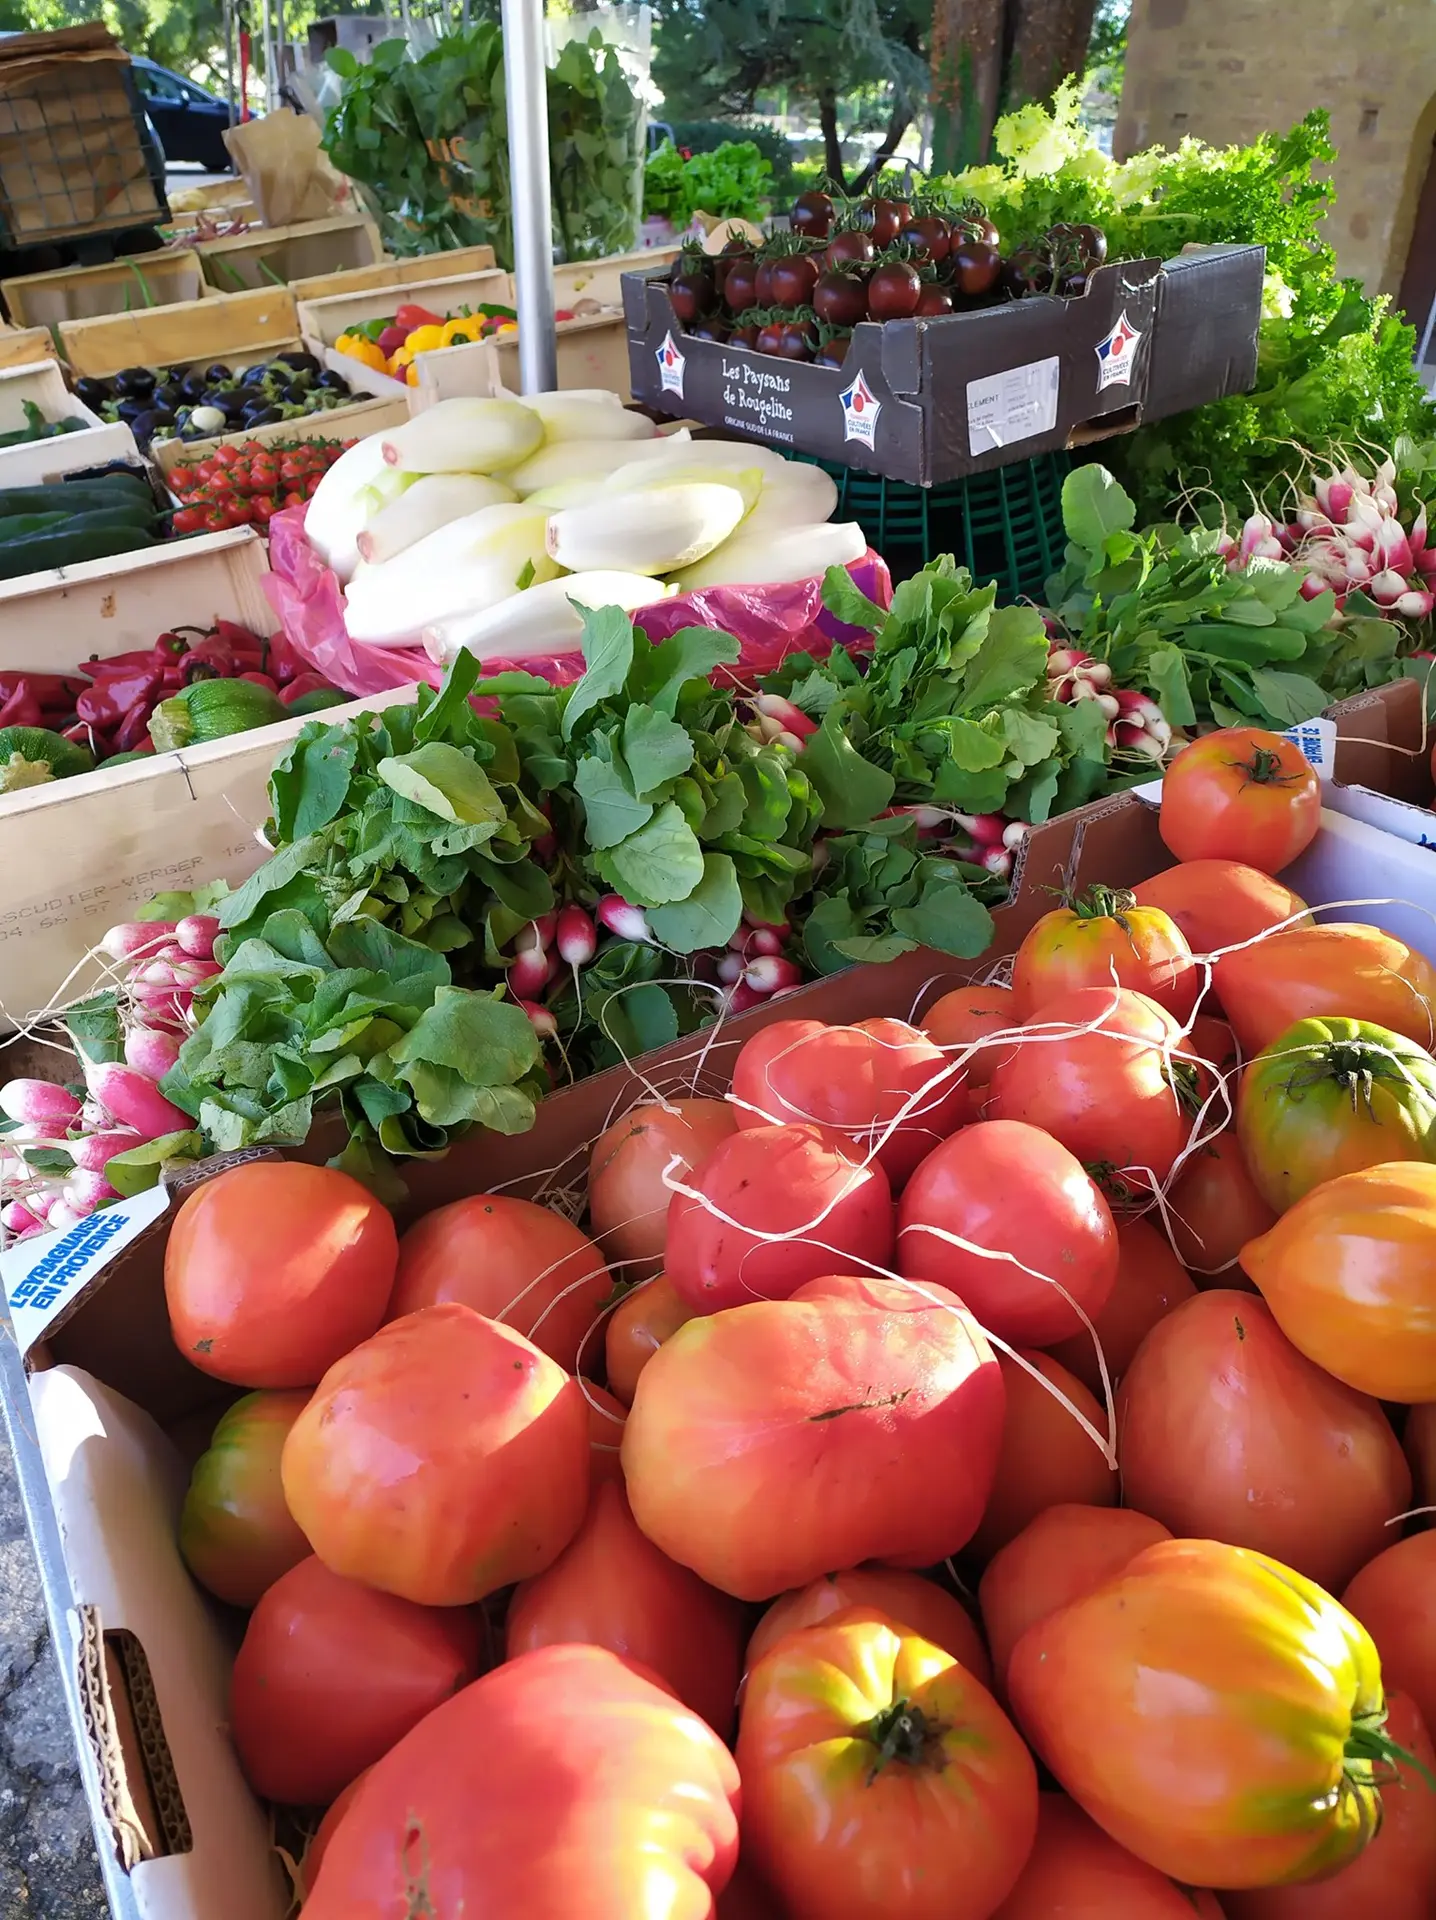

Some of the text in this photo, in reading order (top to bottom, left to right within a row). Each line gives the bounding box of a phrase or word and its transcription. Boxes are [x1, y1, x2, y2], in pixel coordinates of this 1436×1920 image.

[722, 358, 791, 395] Les Paysans
[723, 384, 793, 425] de Rougeline
[772, 430, 794, 443] FRANCE
[0, 856, 205, 926] SCUDIER-VERGER
[9, 1213, 108, 1309] L'EYRAGUAISE
[30, 1214, 131, 1310] EN PROVENCE
